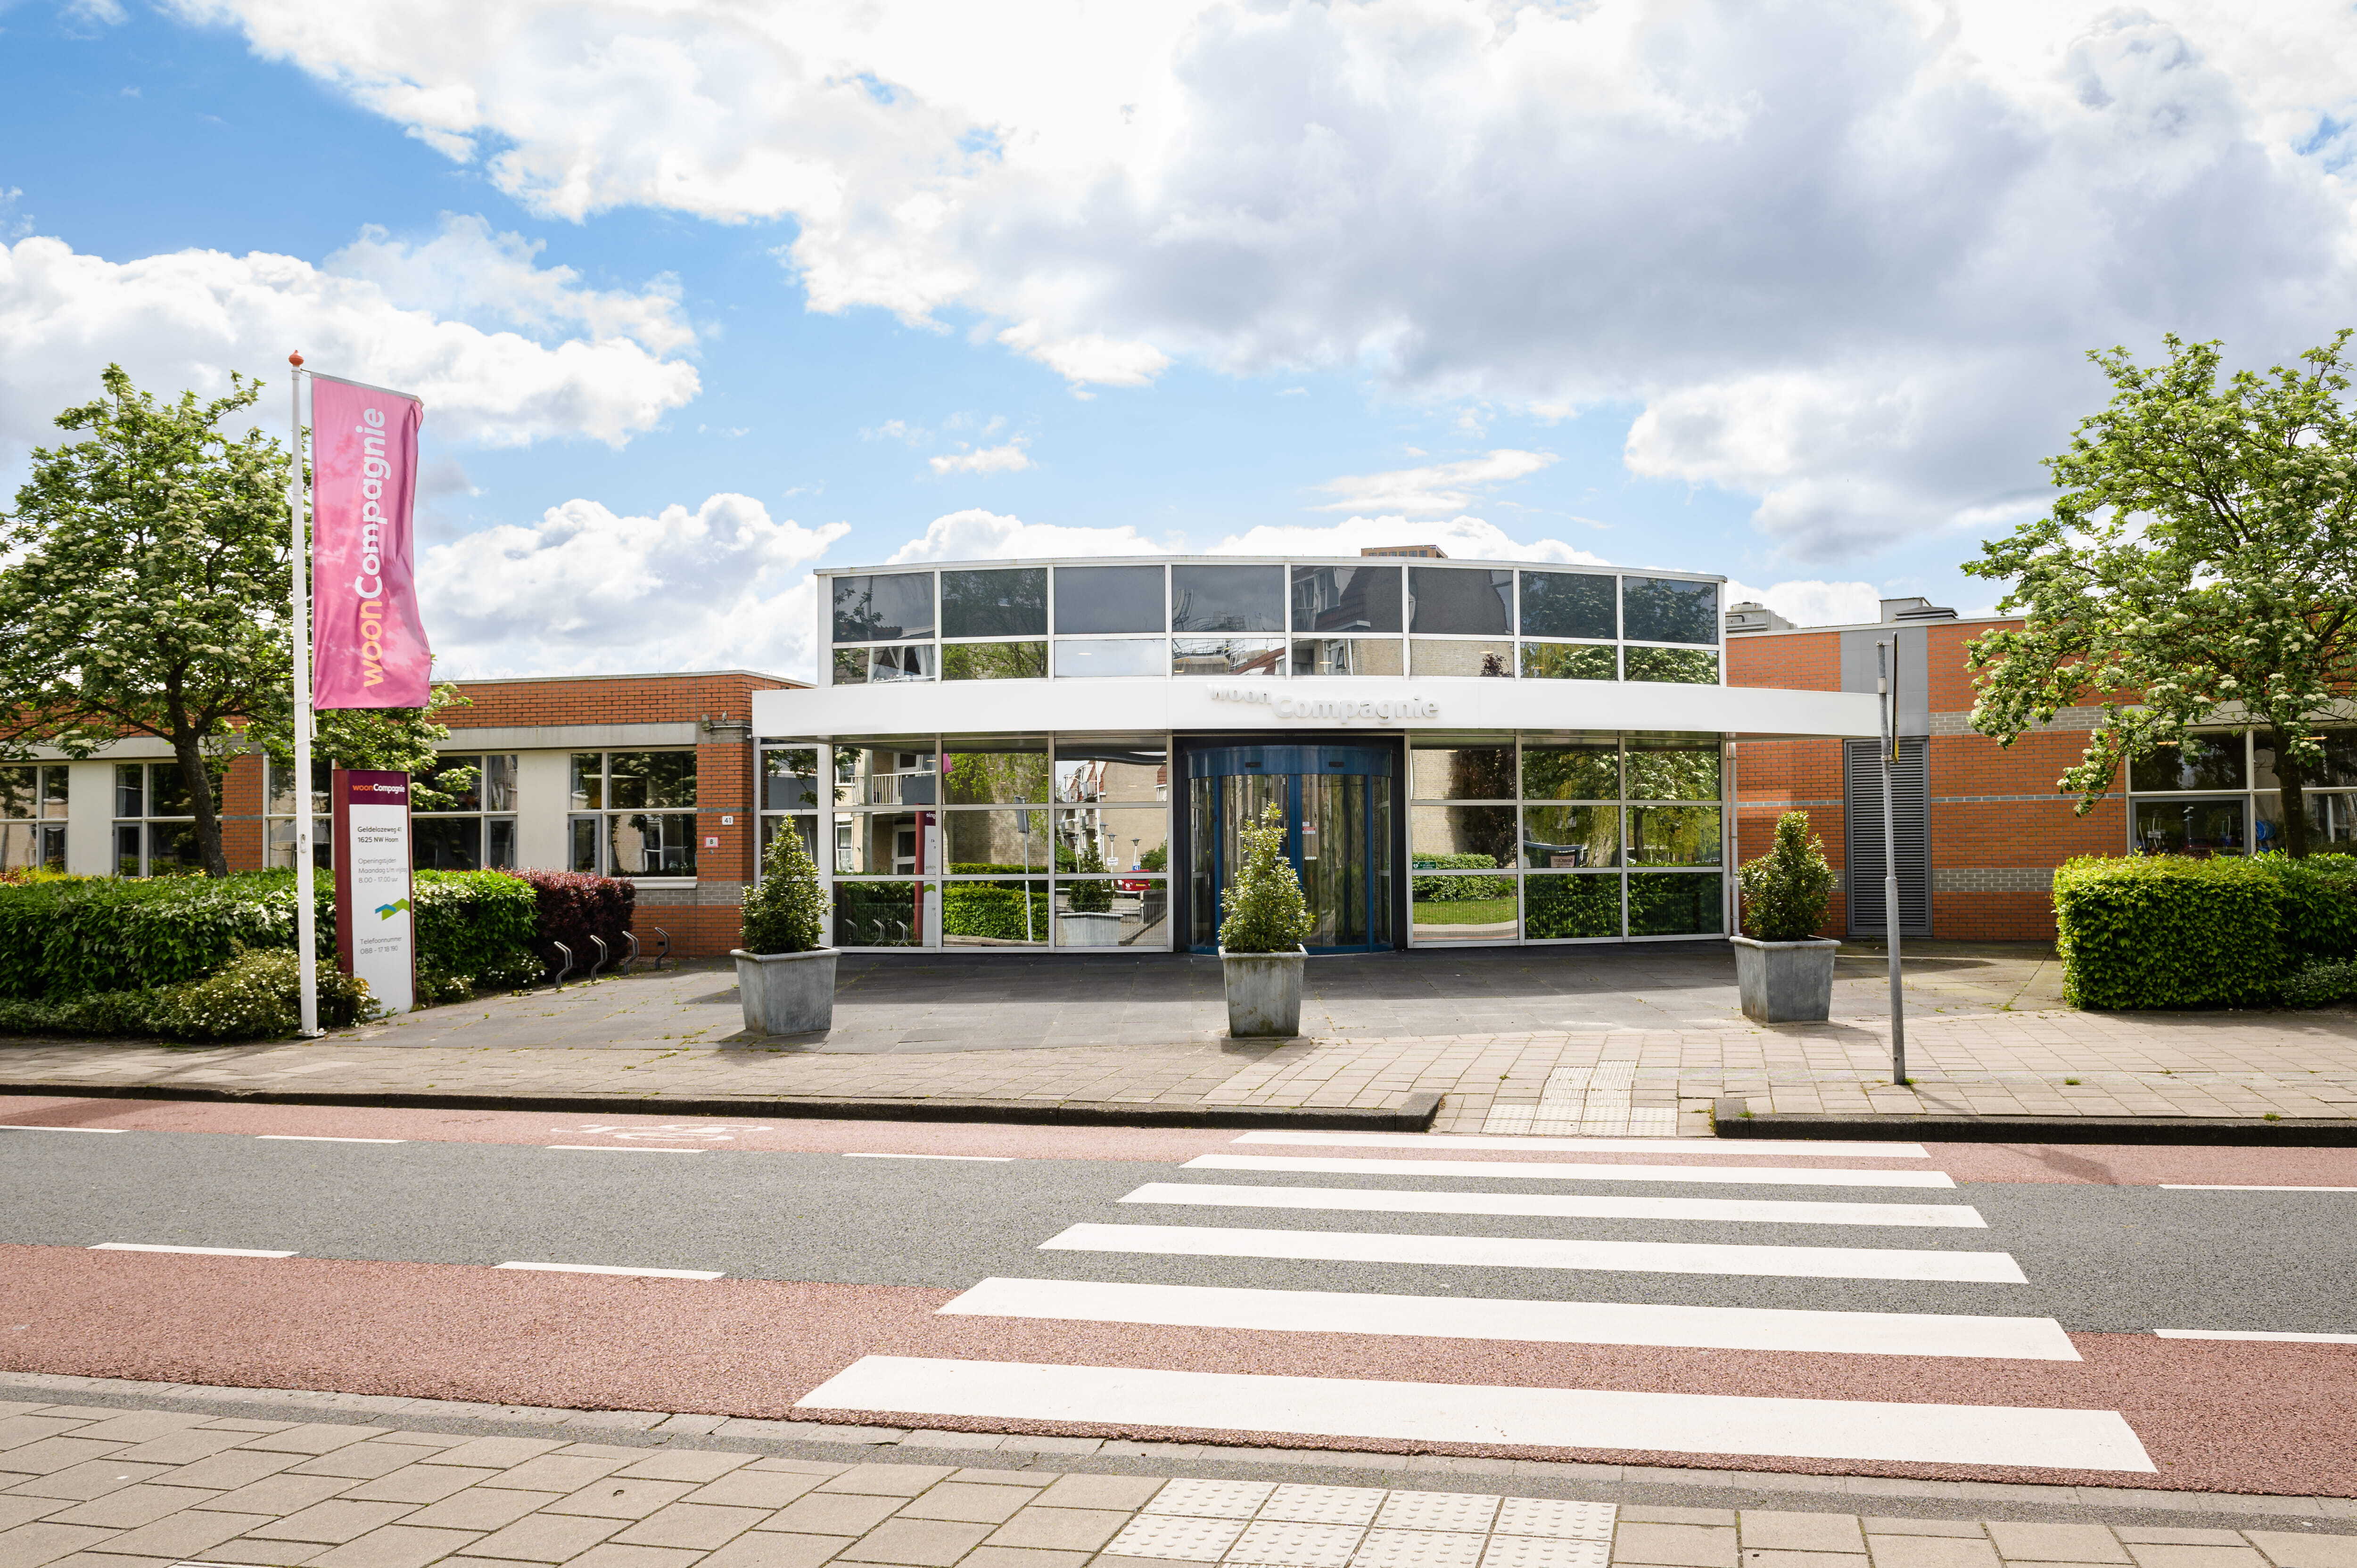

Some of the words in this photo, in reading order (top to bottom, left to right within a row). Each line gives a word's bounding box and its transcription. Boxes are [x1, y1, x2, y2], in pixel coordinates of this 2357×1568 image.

[355, 408, 391, 688] woonCompagnie
[1206, 683, 1440, 724] woonCompagnie
[352, 783, 405, 794] woonCompagnie
